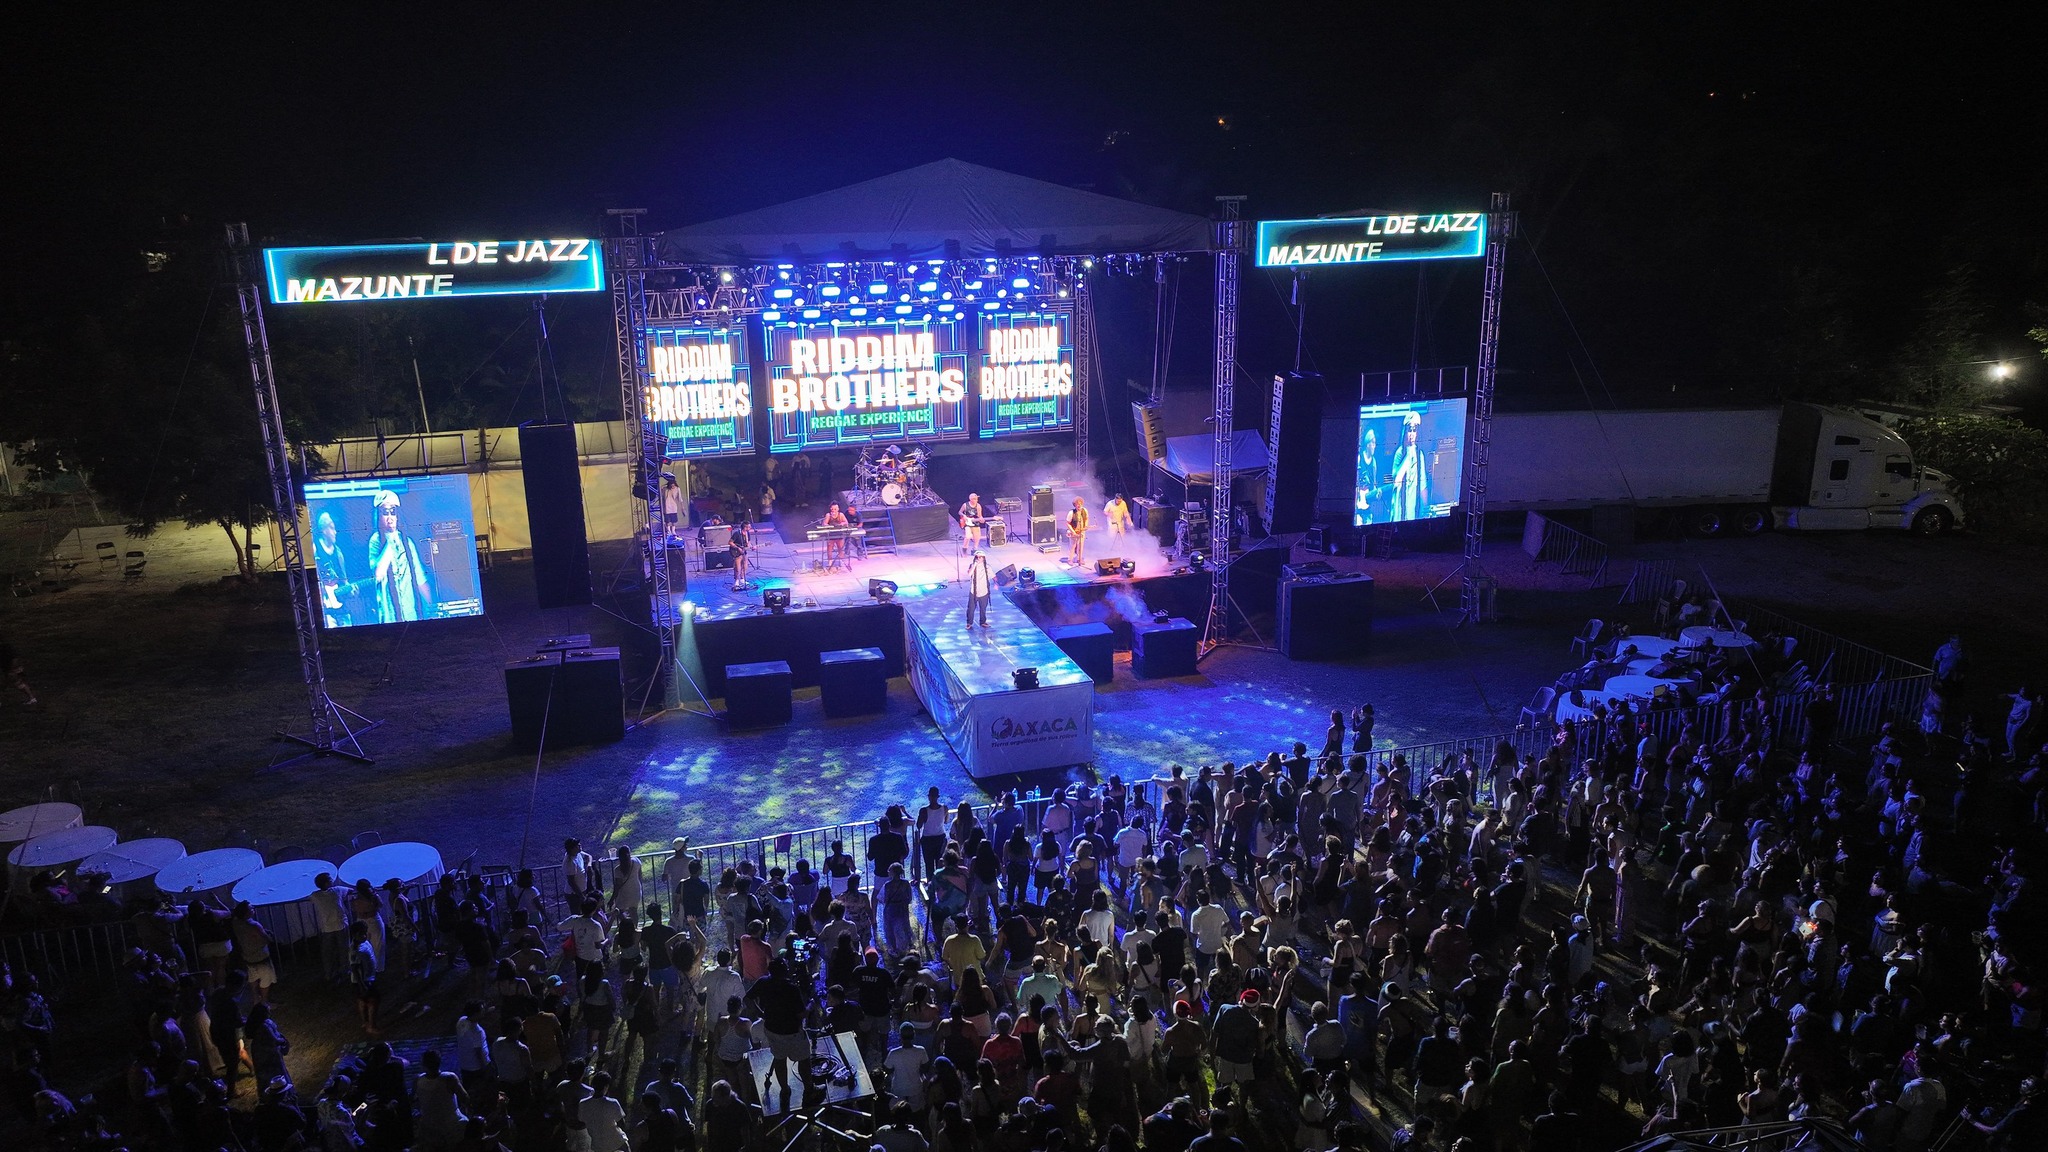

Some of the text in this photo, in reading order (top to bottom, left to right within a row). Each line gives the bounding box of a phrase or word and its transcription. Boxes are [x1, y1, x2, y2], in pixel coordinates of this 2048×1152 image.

[1367, 213, 1480, 235] L DE JAZZ
[428, 239, 590, 265] L DE JAZZ
[1267, 242, 1383, 265] MAZUNTE
[286, 274, 454, 301] MAZUNTE
[791, 333, 935, 375] RIDDIM
[990, 327, 1058, 364] RIDDIM
[653, 344, 733, 383] RIDDIM
[772, 368, 965, 414] BROTHERS
[981, 363, 1072, 400] BROTHERS
[645, 381, 750, 422] BROTHERS
[998, 401, 1056, 416] REGGAE EXPERIENCE
[668, 422, 733, 439] REGGAE EXPERIENCE
[811, 409, 932, 429] REGGAE EXPERIENCE
